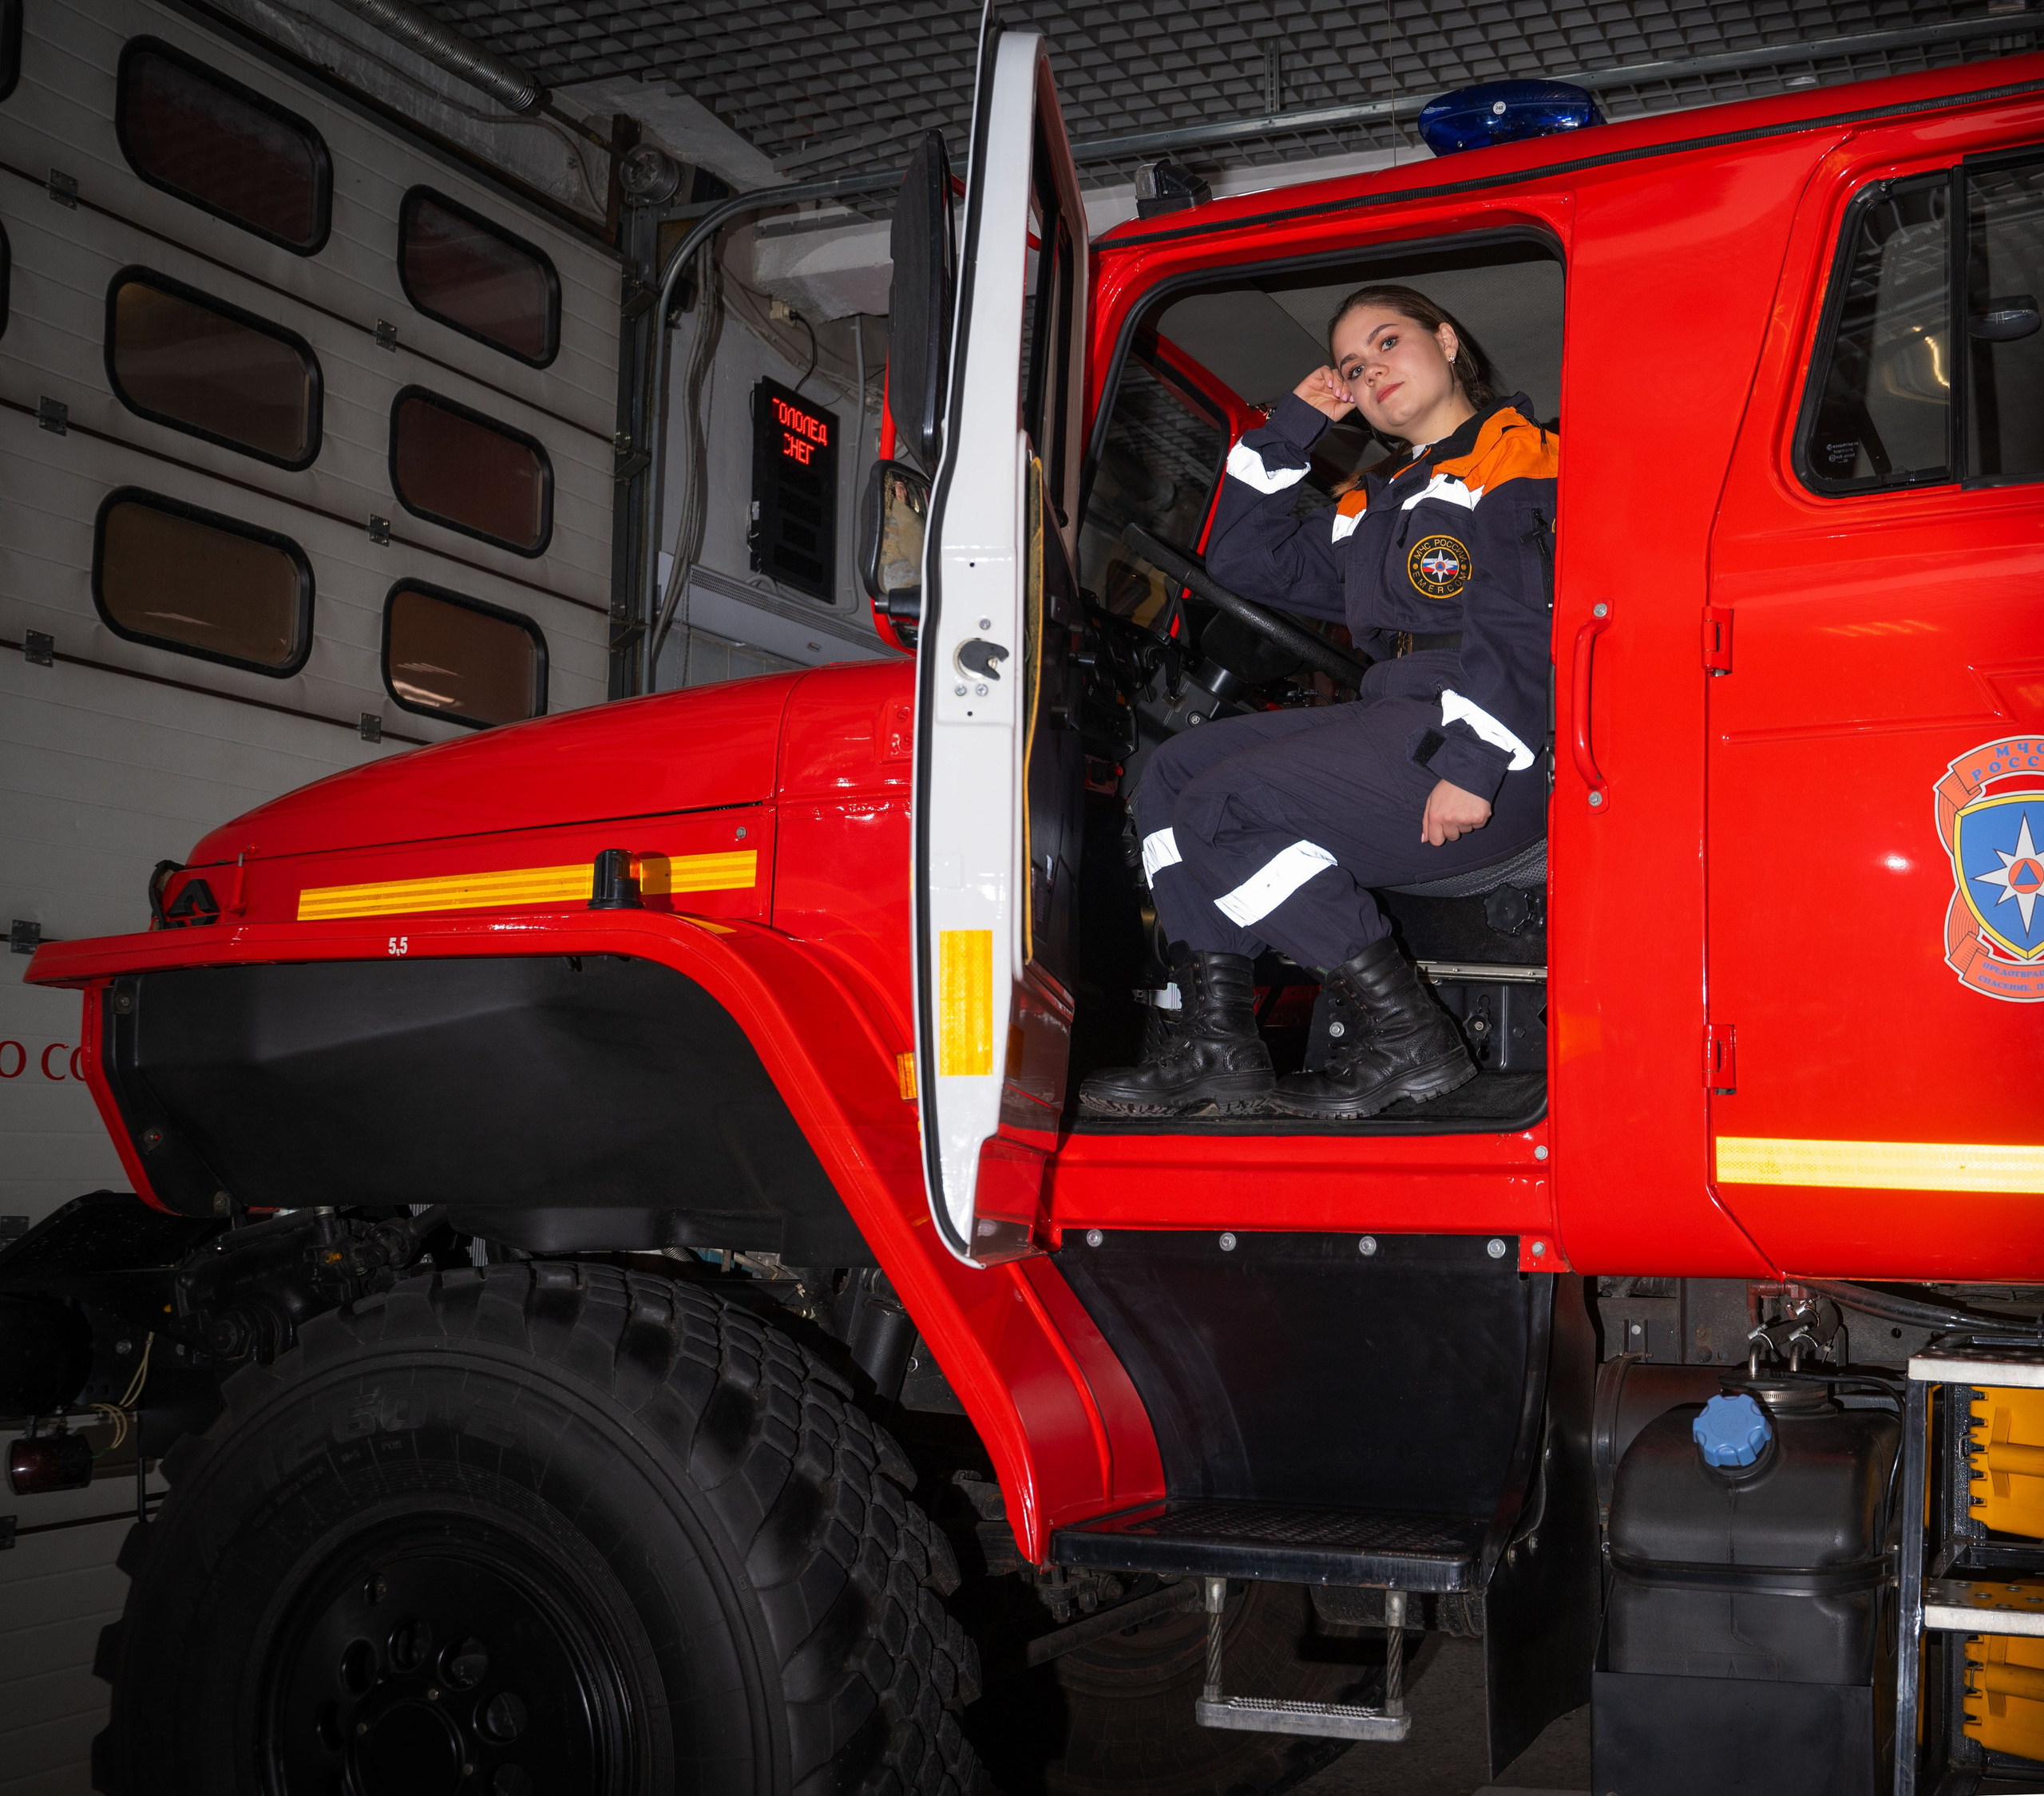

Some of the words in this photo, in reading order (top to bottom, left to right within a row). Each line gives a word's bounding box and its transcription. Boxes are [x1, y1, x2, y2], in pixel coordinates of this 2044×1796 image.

[1413, 542, 1432, 560] МЧС
[1434, 539, 1468, 562] РОССИИ
[1412, 571, 1467, 594] EMERCOM
[388, 936, 408, 956] 5,5
